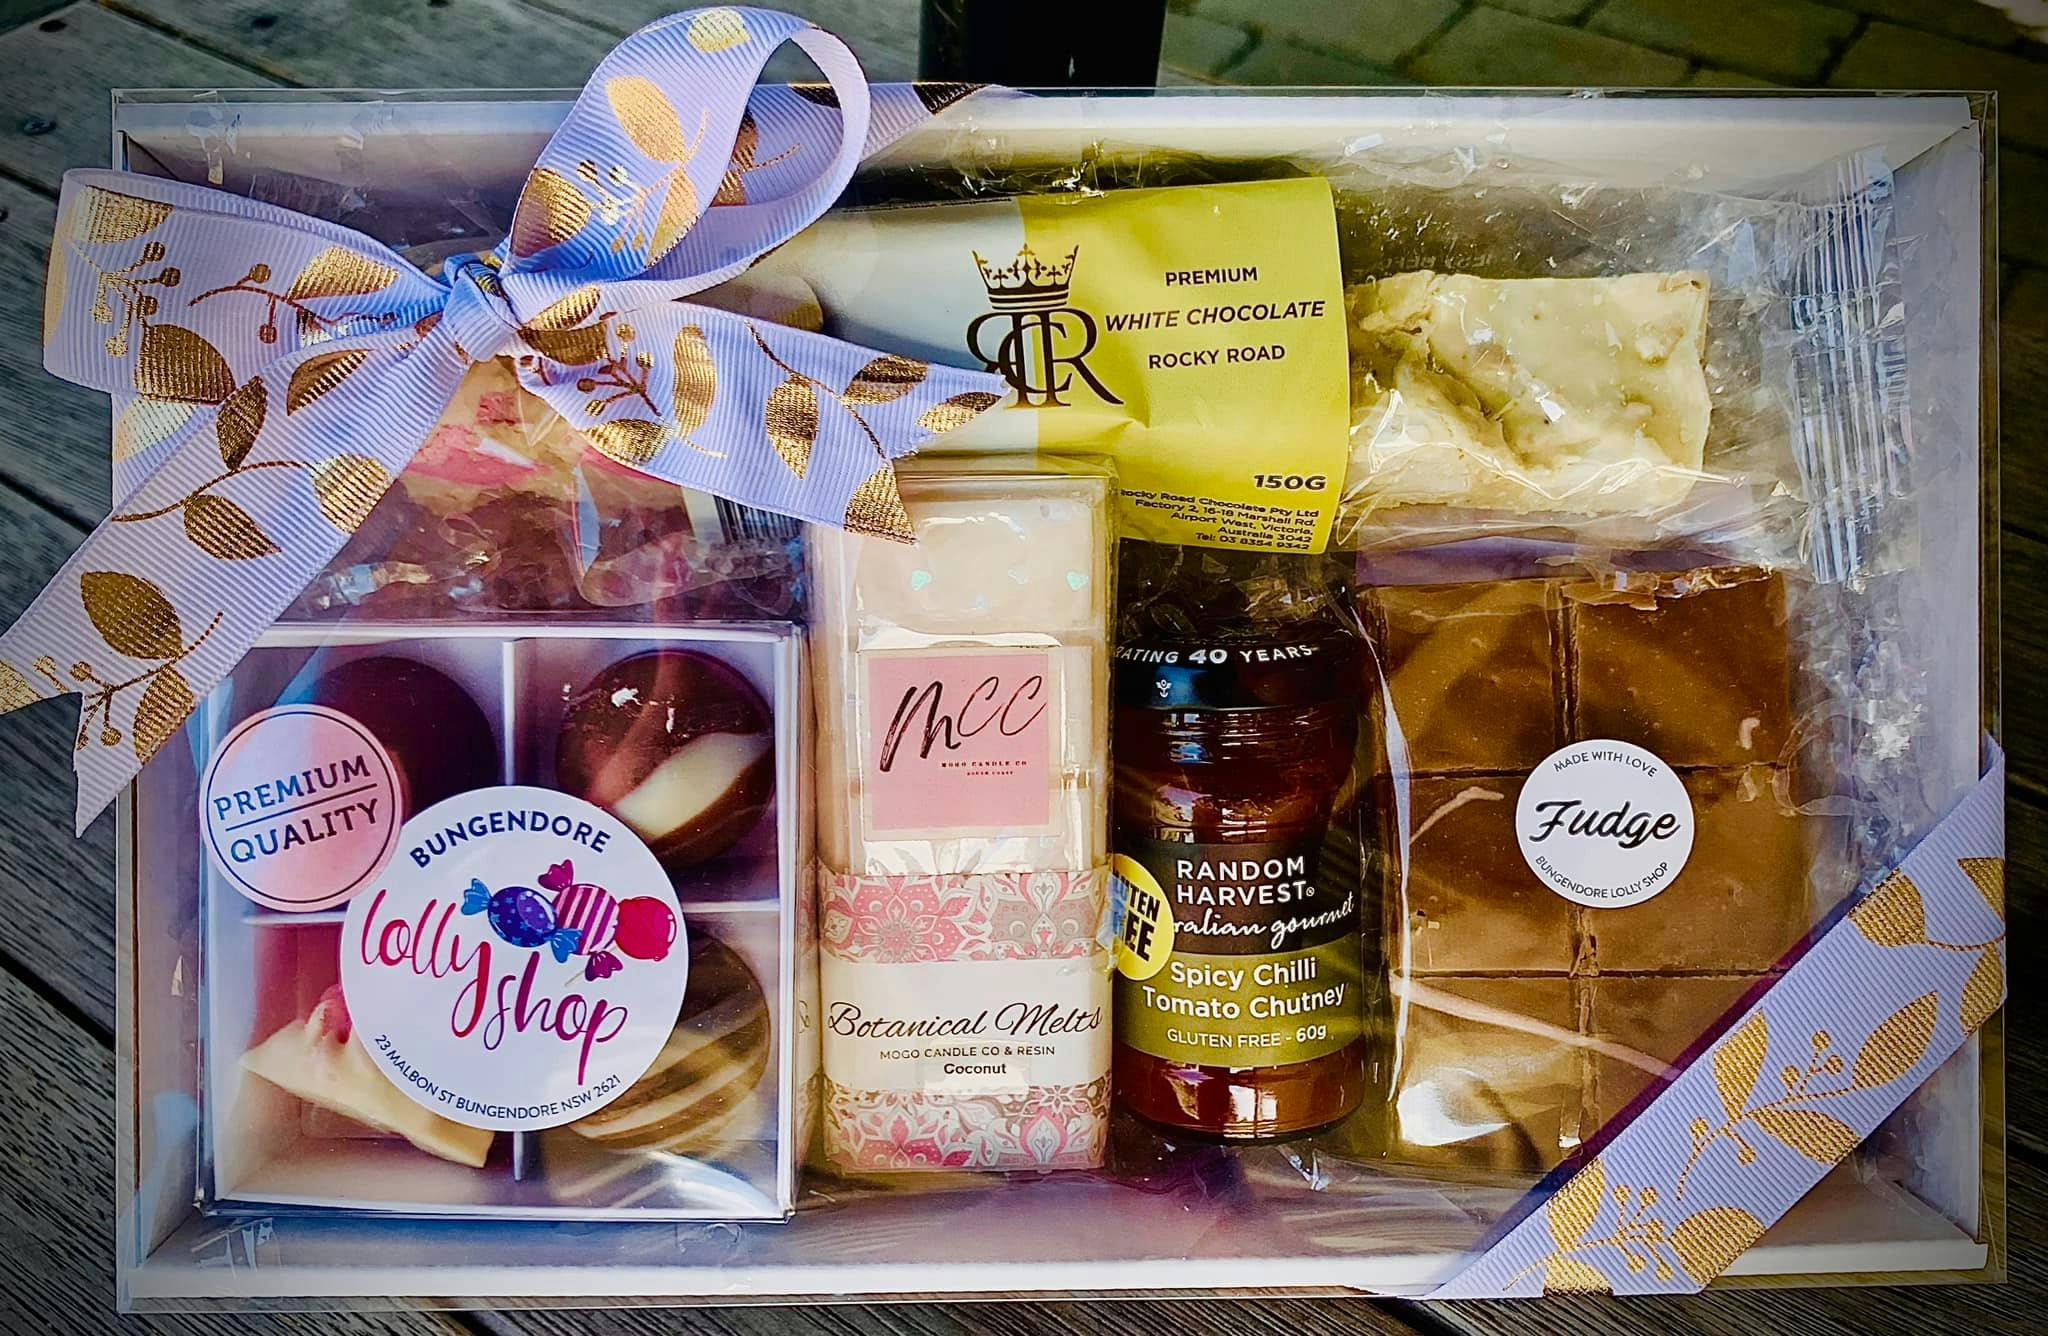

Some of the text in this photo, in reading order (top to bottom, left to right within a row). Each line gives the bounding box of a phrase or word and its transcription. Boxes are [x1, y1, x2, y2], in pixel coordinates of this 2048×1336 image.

[1165, 267, 1258, 286] PREMIUM
[1105, 301, 1326, 332] WHITE CHOCOLATE
[1149, 345, 1285, 369] ROCKY ROAD
[1254, 475, 1326, 490] 150G
[1136, 499, 1184, 511] Factory
[1203, 507, 1234, 517] 16-18
[1238, 512, 1290, 525] Marshall
[1161, 493, 1195, 503] Road
[1199, 498, 1266, 512] Chocolate
[1270, 507, 1293, 516] Pty
[1296, 510, 1319, 518] Ltd
[1171, 512, 1217, 523] Airport
[1195, 532, 1216, 541] Tel:
[1219, 536, 1236, 544] 03
[1217, 526, 1312, 543] Australia 3042
[1115, 644, 1312, 664] RATING 40 YEARS
[1553, 751, 1658, 778] MADE WITH LOVE
[214, 755, 371, 821] PREMIUM
[230, 798, 378, 863] QUALITY
[1529, 799, 1681, 849] Fudge
[409, 809, 612, 868] BUNGENDORE
[1177, 856, 1304, 881] RANDOM
[1535, 855, 1670, 898] BUNGENDORE LOLLY SHOP
[1174, 891, 1354, 949] ralian gourmet
[1170, 957, 1316, 991] Spicy Chilli
[1142, 983, 1345, 1019] Tomato Chutney
[483, 950, 628, 1086] shop
[828, 1001, 989, 1038] Botanical
[995, 1002, 1102, 1036] Melts
[1167, 1028, 1233, 1048] GLUTEN
[1237, 1033, 1281, 1048] FREE
[1296, 1025, 1327, 1043] 60g
[879, 1045, 1055, 1060] MOGO CANDLE CO & RESIN
[374, 1034, 622, 1119] 23 MALBON ST BUNGENDORE NSW 2621
[943, 1062, 1007, 1075] Coconut
